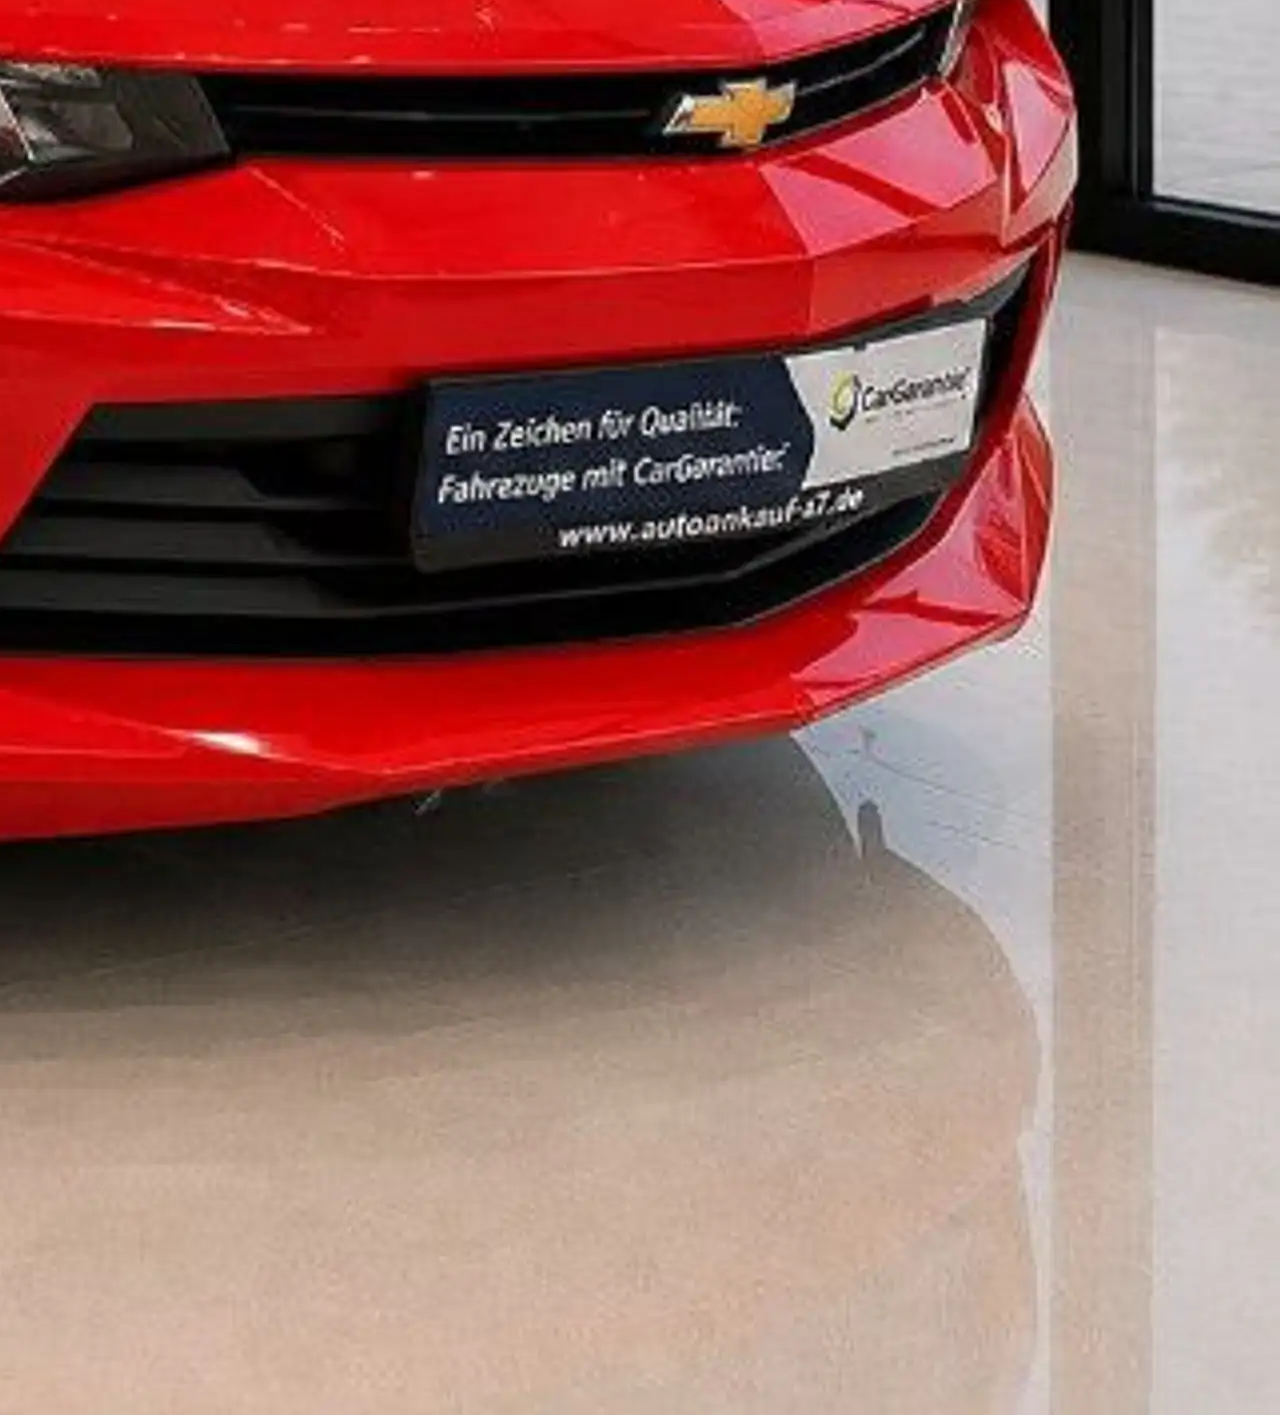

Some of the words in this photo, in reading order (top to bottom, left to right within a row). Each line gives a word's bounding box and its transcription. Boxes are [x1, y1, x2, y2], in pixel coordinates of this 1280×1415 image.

[446, 423, 487, 455] Ein
[493, 414, 591, 451] Zeichen
[598, 410, 635, 440] für
[582, 458, 627, 491] mit
